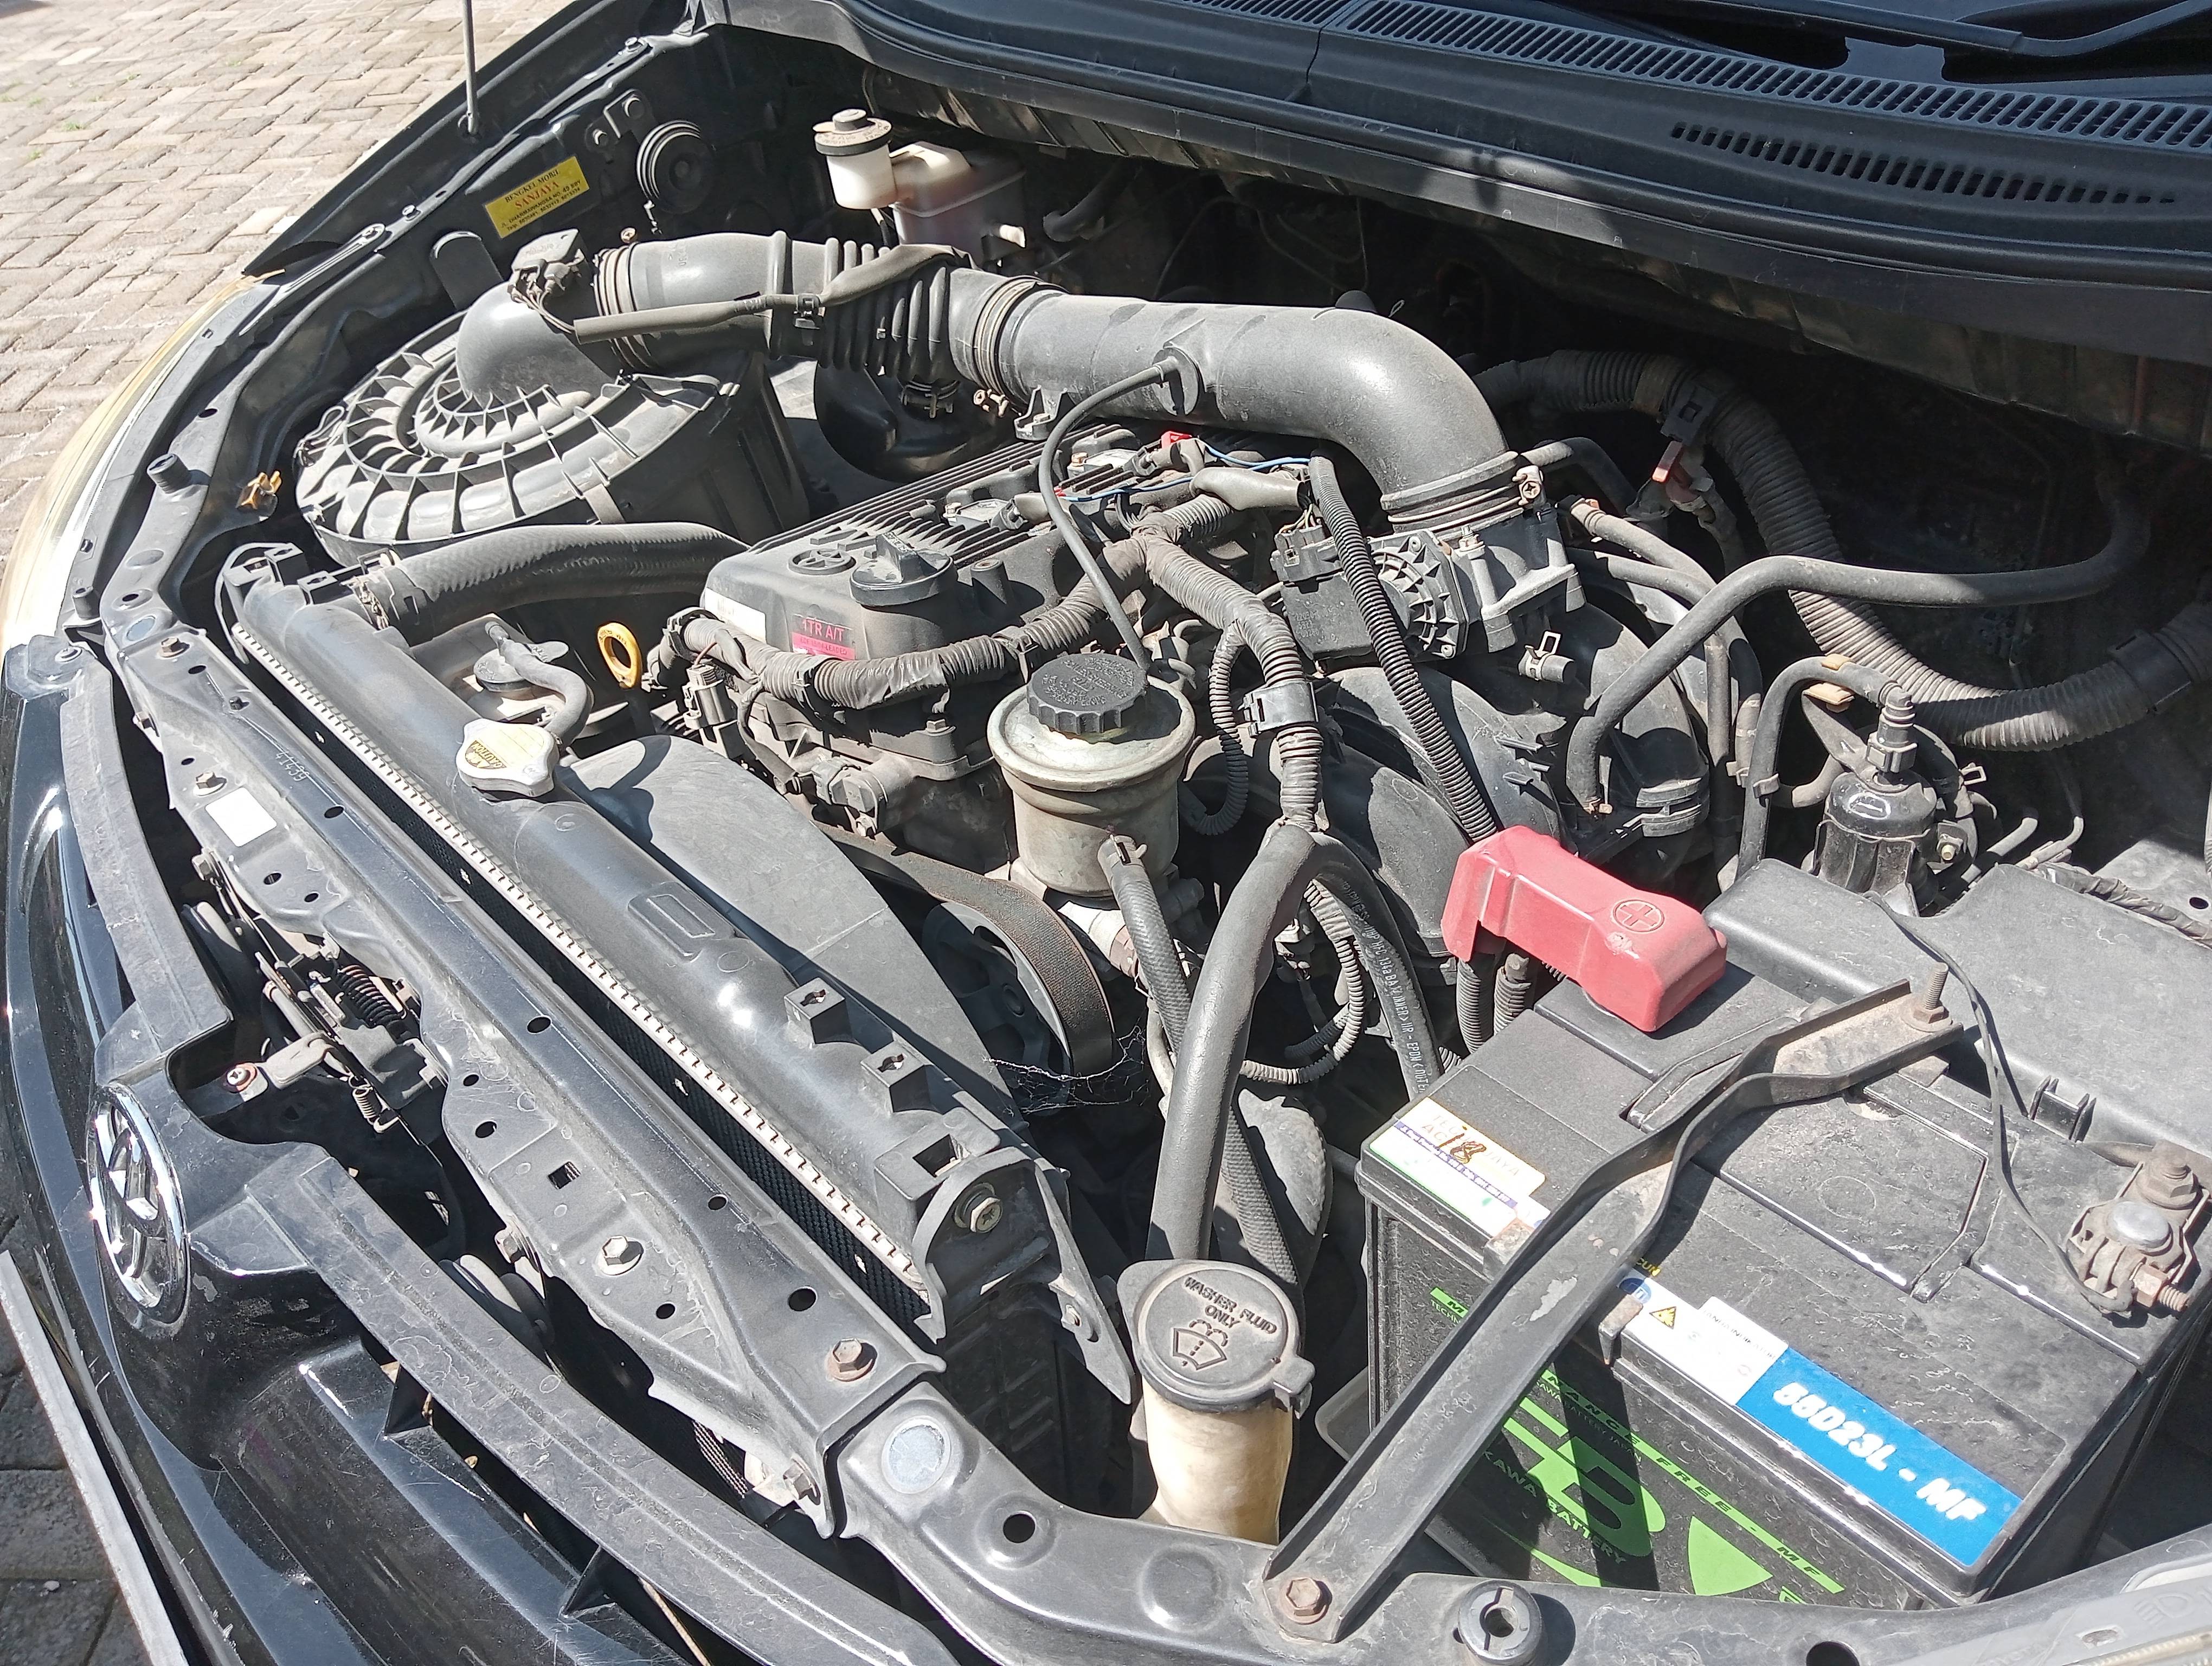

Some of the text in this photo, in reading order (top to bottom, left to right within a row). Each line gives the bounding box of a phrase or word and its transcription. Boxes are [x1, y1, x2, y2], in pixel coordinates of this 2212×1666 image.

[505, 169, 560, 203] BENGKEL MOBIL
[515, 181, 560, 209] SANJAYA
[802, 619, 845, 642] 1TR A/T
[472, 743, 503, 768] CAUTION
[1379, 957, 1392, 975] 134a
[1184, 1277, 1277, 1335] WASHER FLUID
[1205, 1305, 1240, 1328] ONLY
[1772, 1381, 1898, 1472] 55D23L
[1917, 1477, 1987, 1522] MF
[1547, 1498, 1626, 1564] BATTERY
[1656, 1457, 1732, 1512] FREE
[1777, 1547, 1820, 1575] MF
